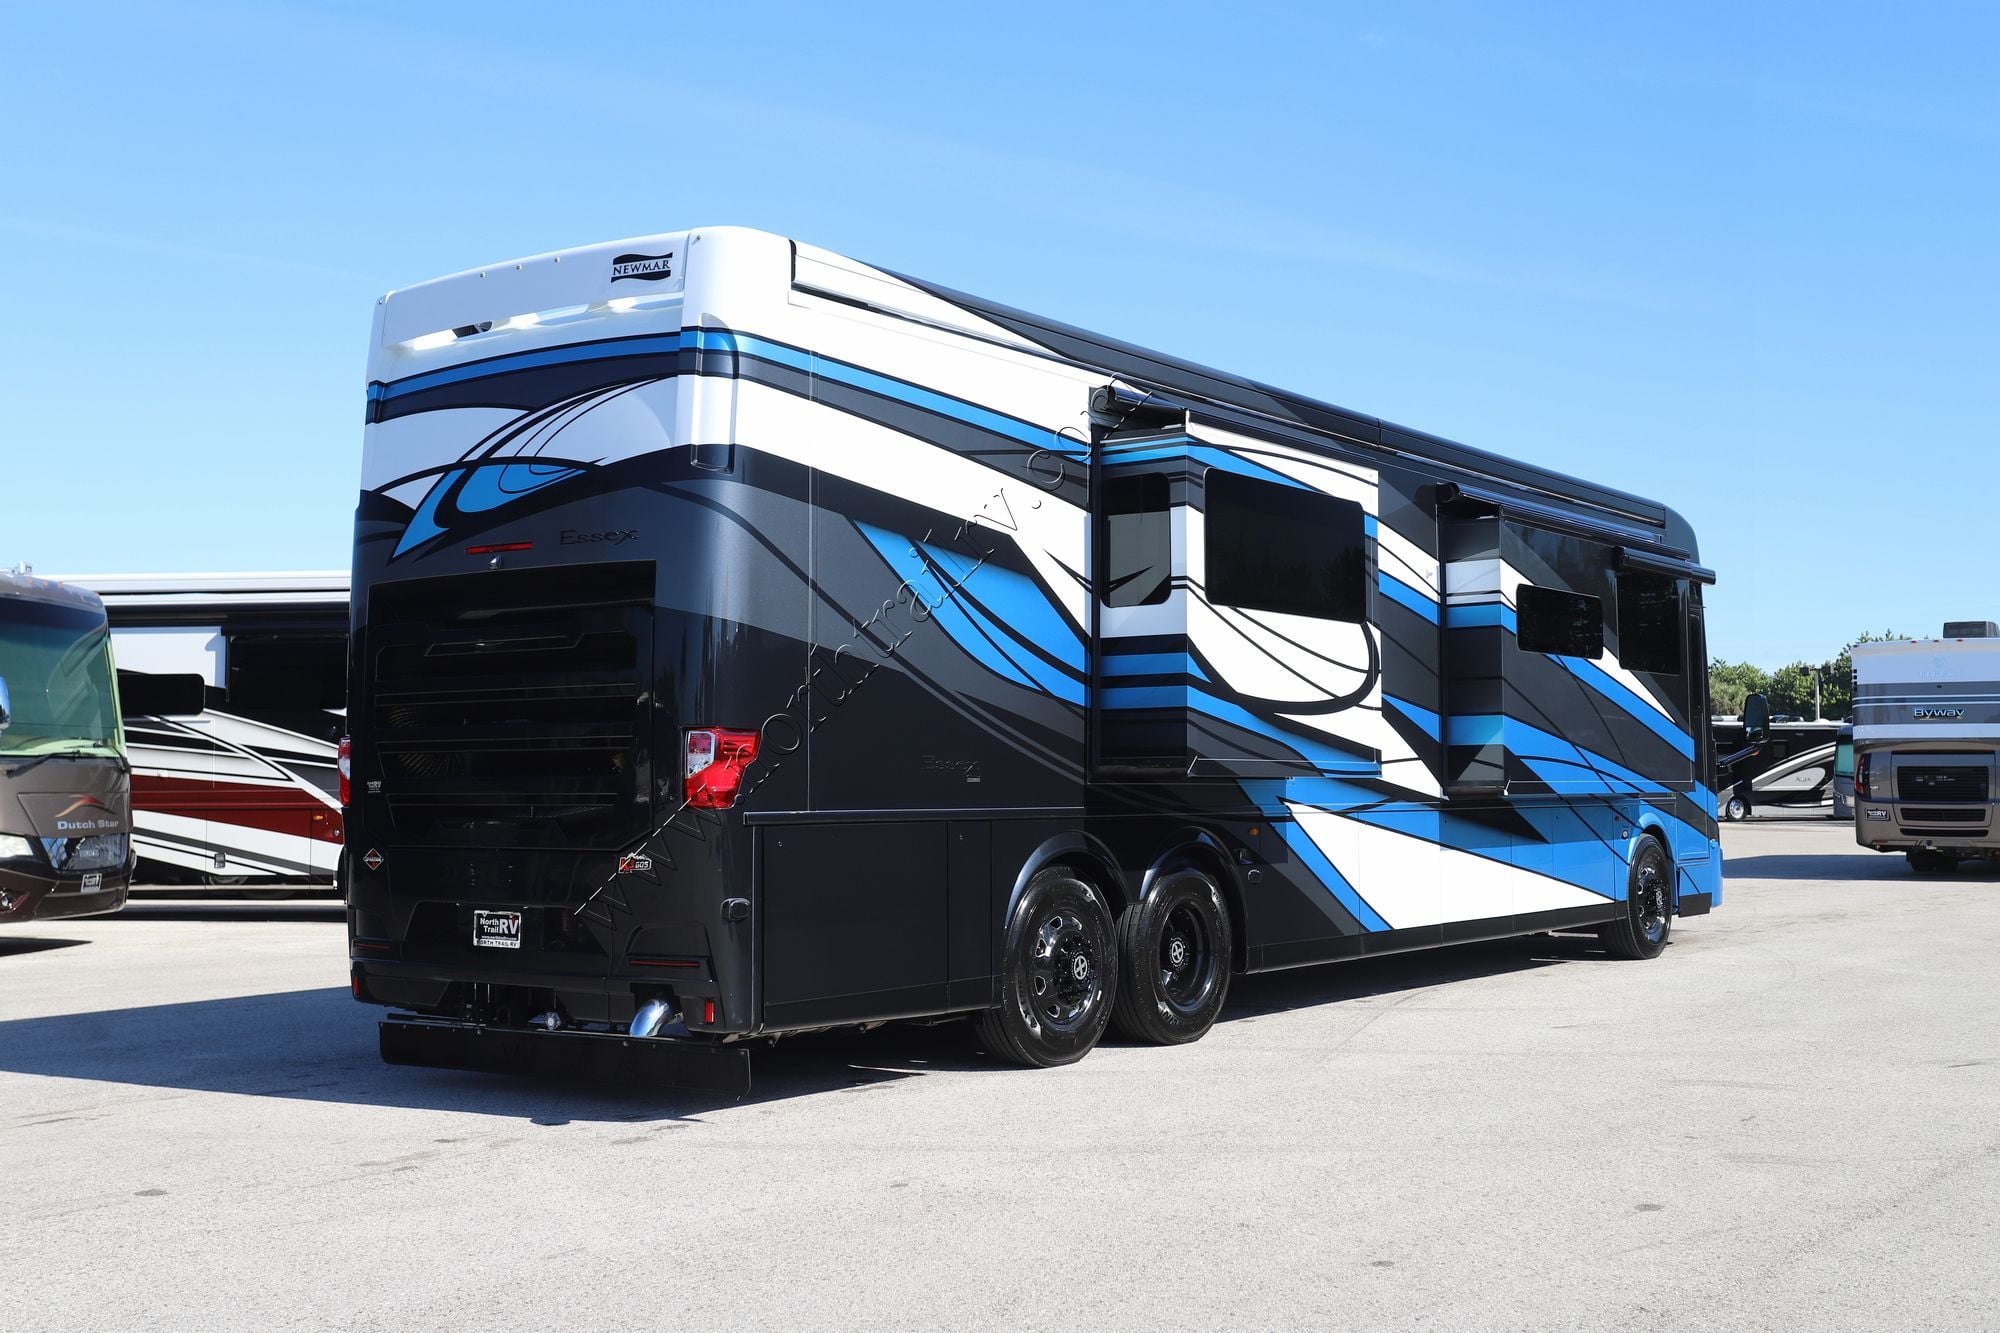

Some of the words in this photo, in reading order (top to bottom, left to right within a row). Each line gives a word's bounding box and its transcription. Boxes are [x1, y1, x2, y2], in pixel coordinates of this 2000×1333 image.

[613, 259, 671, 275] NEWMAR
[560, 528, 639, 546] Essex
[1914, 708, 1964, 720] Byway
[57, 820, 96, 830] Dutch
[98, 819, 119, 828] Star
[480, 917, 499, 926] North
[500, 918, 519, 935] RV
